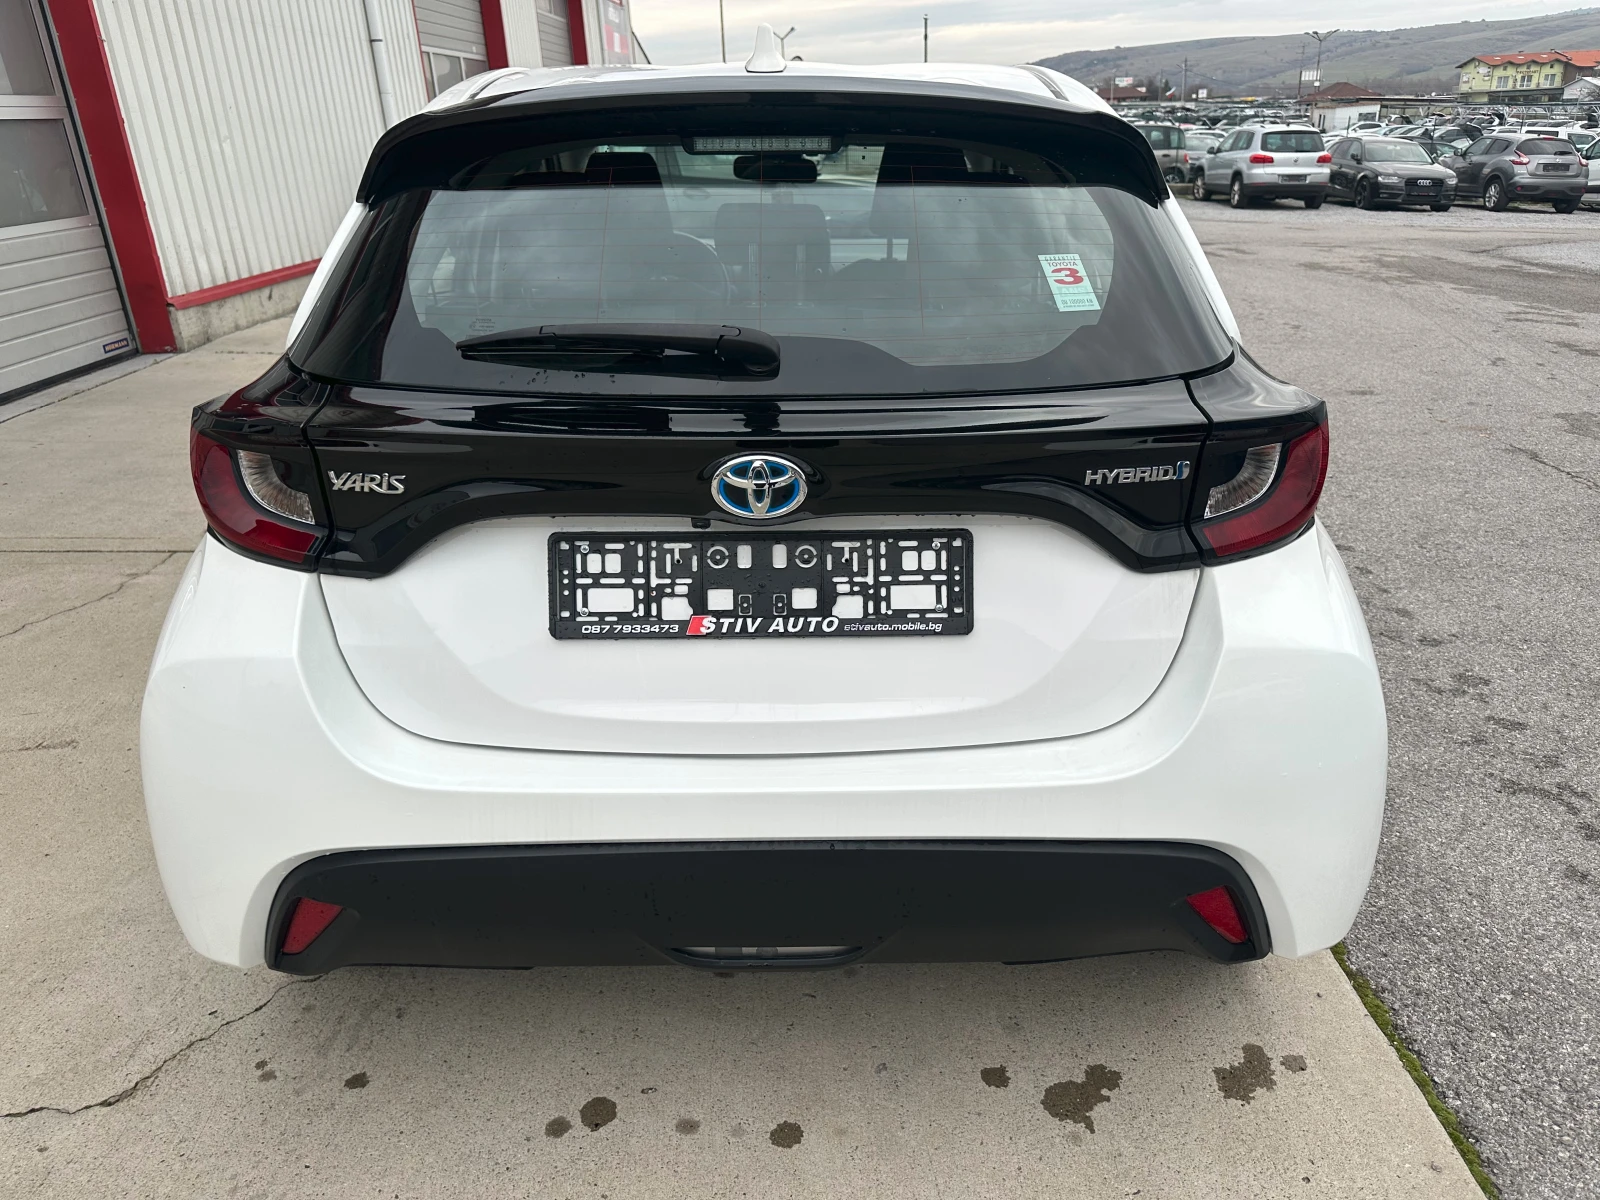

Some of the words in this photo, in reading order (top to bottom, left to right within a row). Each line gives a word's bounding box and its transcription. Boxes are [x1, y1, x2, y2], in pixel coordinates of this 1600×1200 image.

[1051, 267, 1084, 285] 3
[327, 470, 406, 494] YARIS
[1084, 465, 1175, 485] HYBRID
[700, 616, 764, 633] STIV
[768, 616, 840, 633] AUTO
[843, 621, 943, 632] stivauto.mobile.bg
